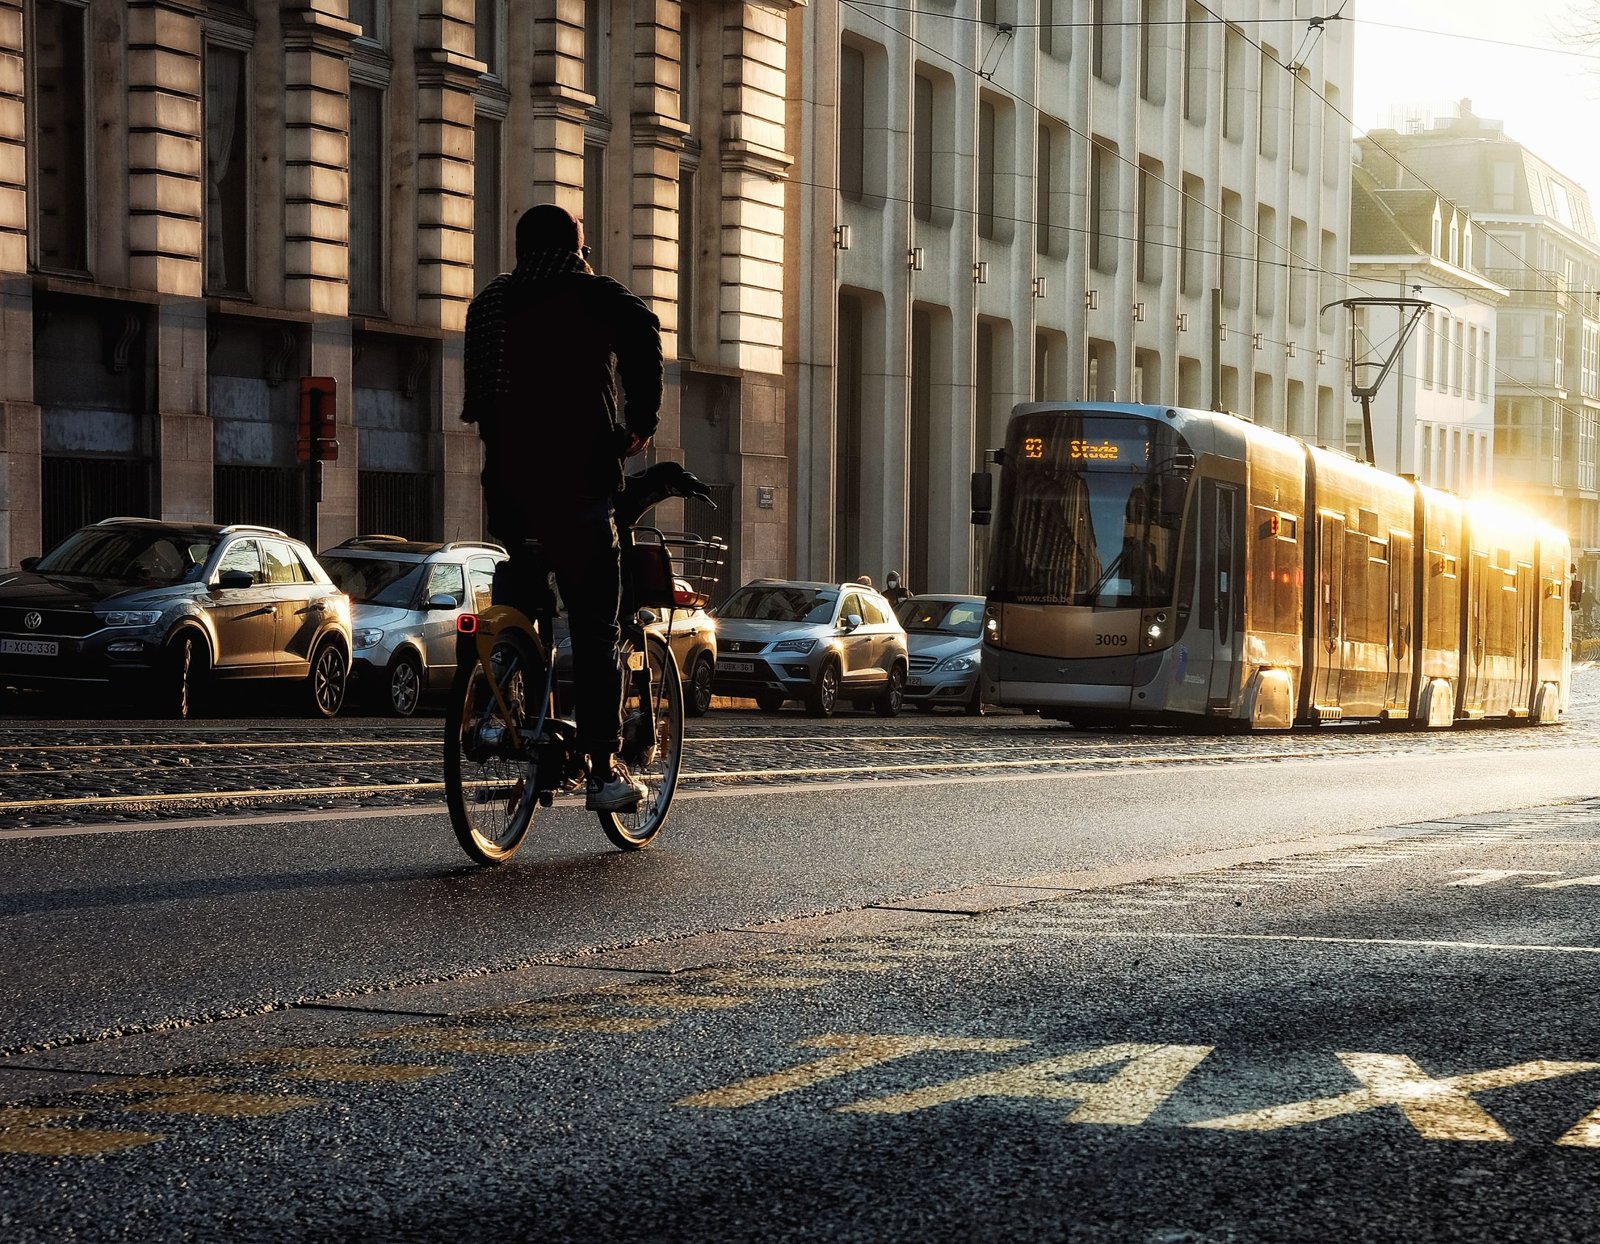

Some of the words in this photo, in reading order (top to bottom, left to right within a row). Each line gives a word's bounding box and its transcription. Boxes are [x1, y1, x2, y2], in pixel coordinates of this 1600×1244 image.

[1070, 440, 1118, 458] Stade
[3, 641, 56, 654] 1-XCC-338
[1095, 633, 1128, 647] 3009
[677, 1033, 1600, 1147] TAX
